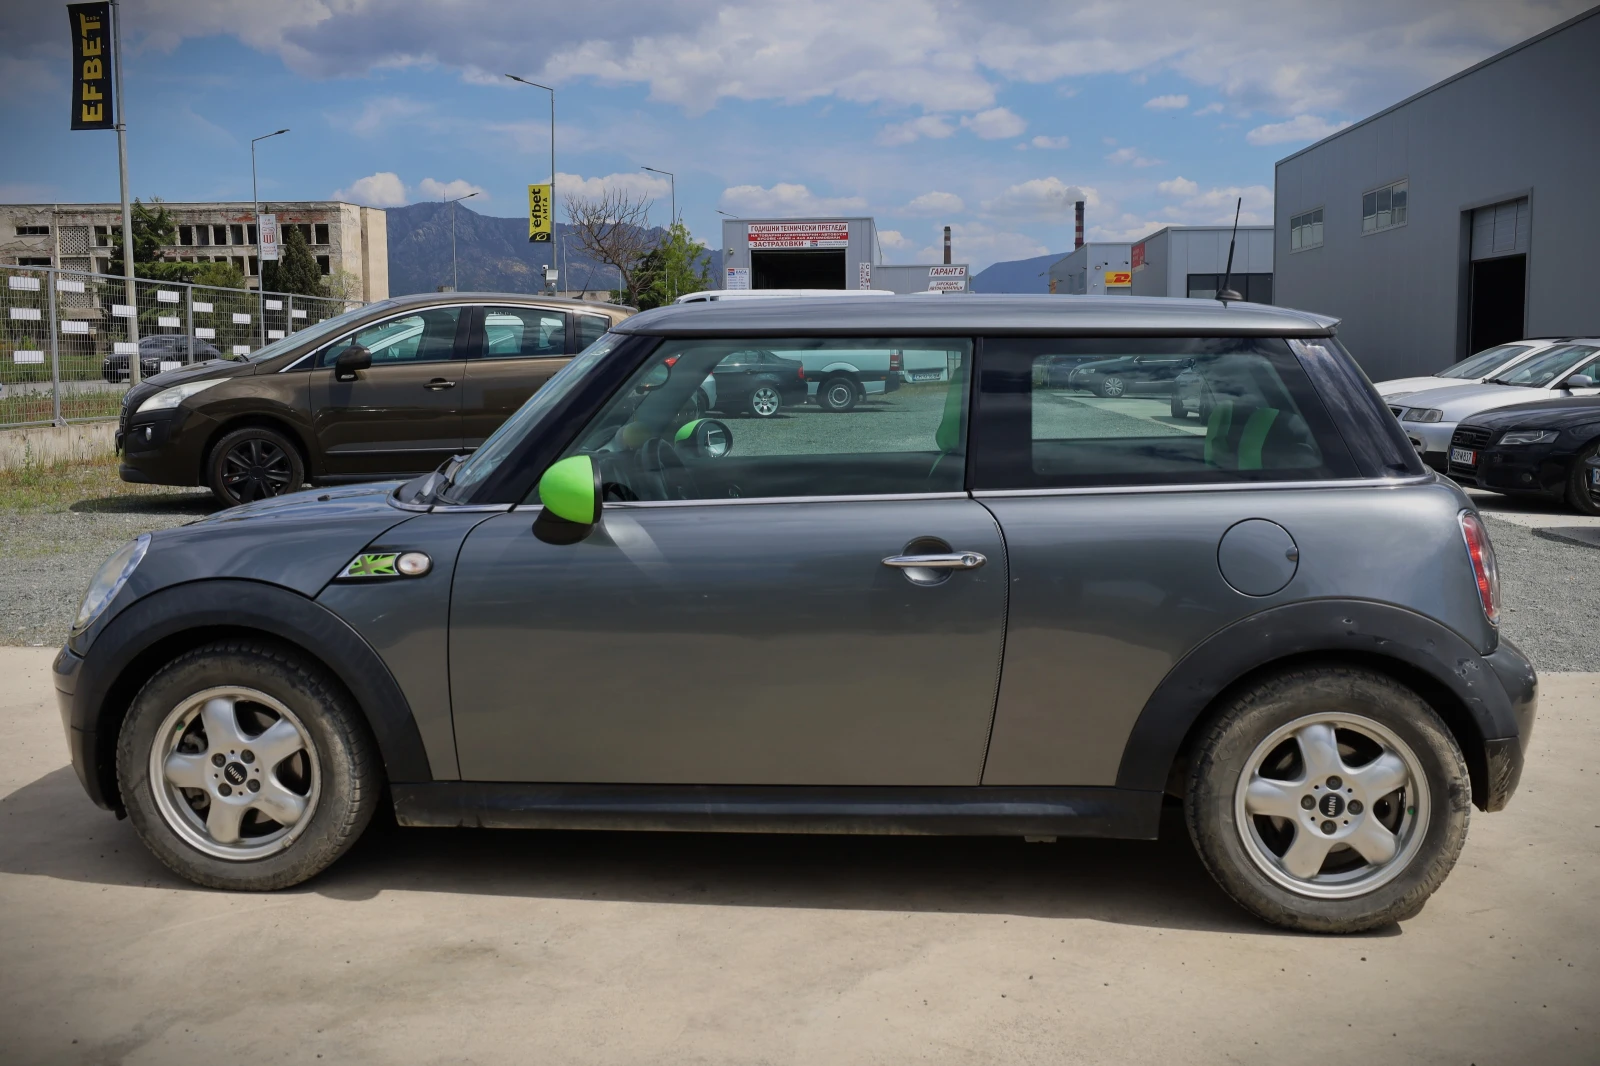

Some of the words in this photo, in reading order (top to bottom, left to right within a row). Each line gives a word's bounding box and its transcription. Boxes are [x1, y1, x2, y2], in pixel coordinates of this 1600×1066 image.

[80, 13, 103, 122] EFBET
[531, 188, 542, 228] efbet
[750, 225, 780, 233] ГОДИШНИ
[781, 224, 817, 232] ТЕХНИЧЕСКИ
[227, 764, 243, 782] MINI
[1327, 796, 1337, 816] MINI
